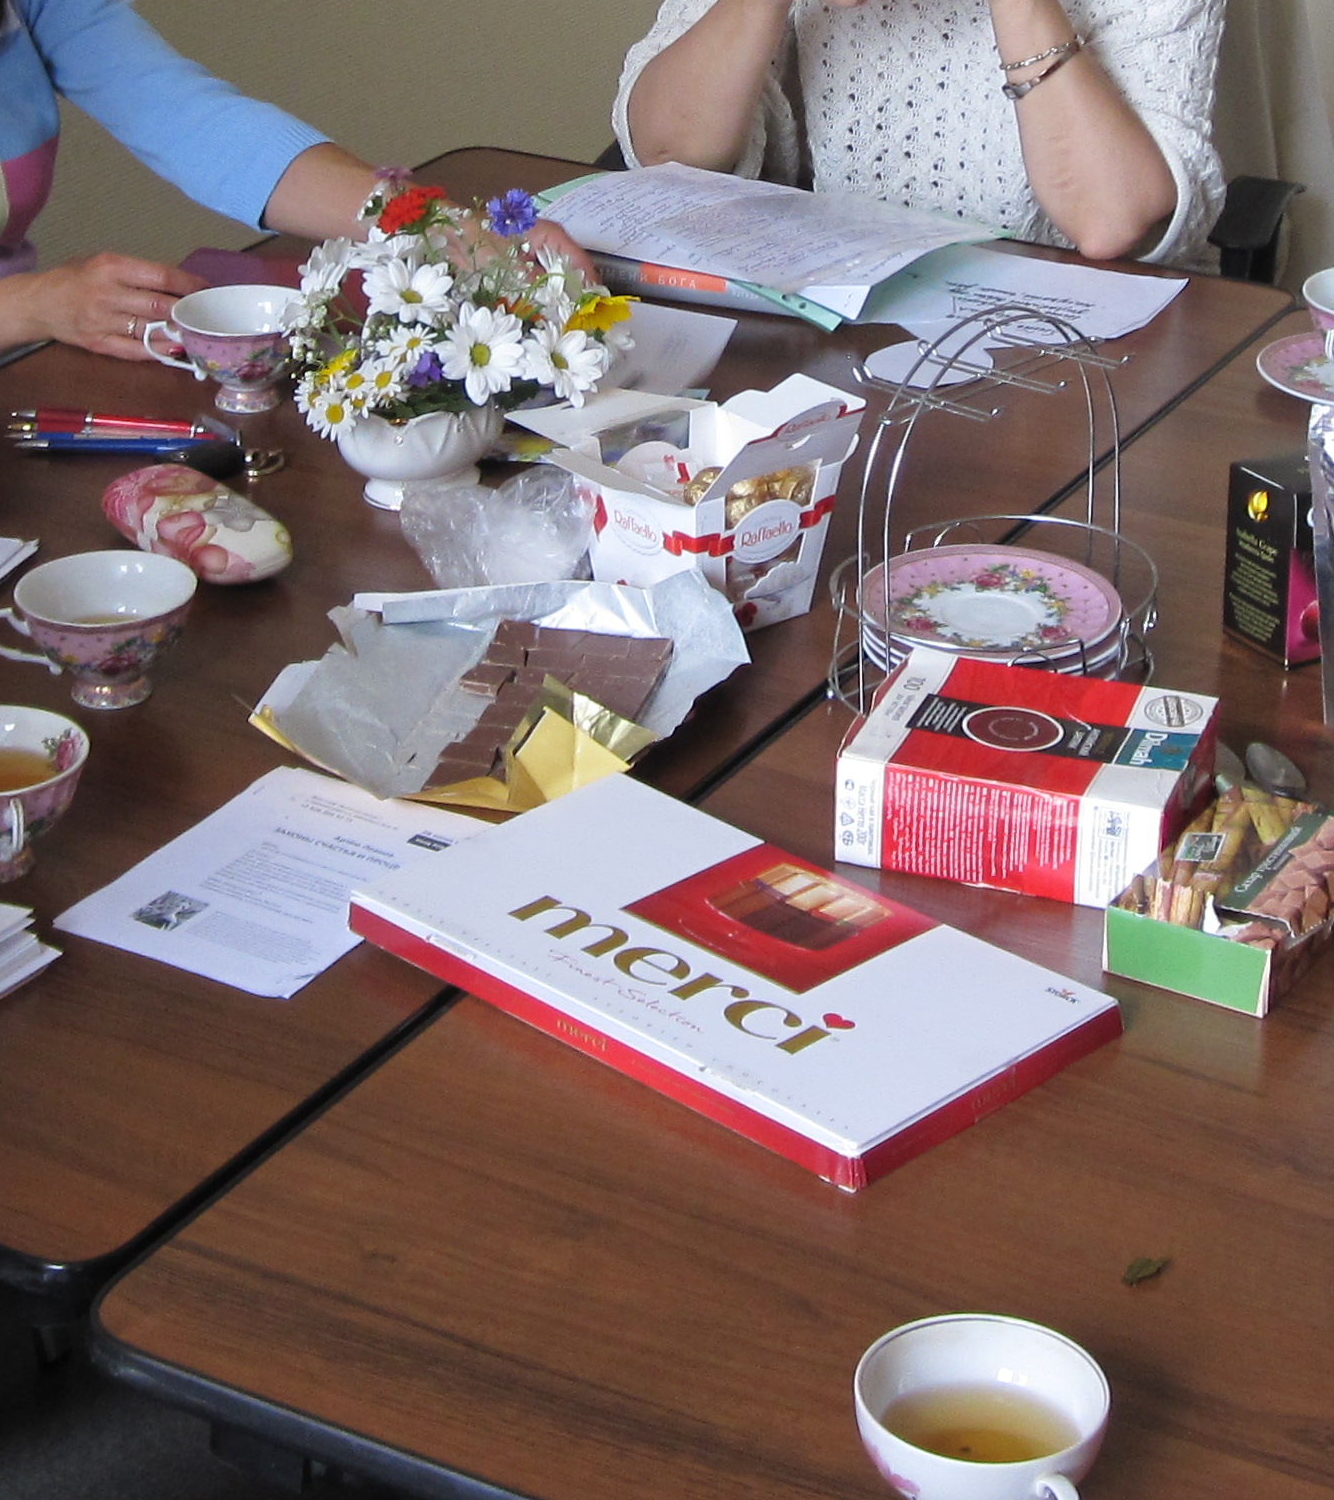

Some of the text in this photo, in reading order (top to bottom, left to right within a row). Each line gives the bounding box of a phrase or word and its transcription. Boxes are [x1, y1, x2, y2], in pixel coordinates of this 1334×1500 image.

[657, 275, 697, 290] БОГА
[613, 509, 657, 544] Raffaello
[740, 518, 793, 548] Raffaello
[507, 895, 856, 1055] merci
[616, 986, 705, 1036] Selection
[555, 1019, 607, 1053] merci
